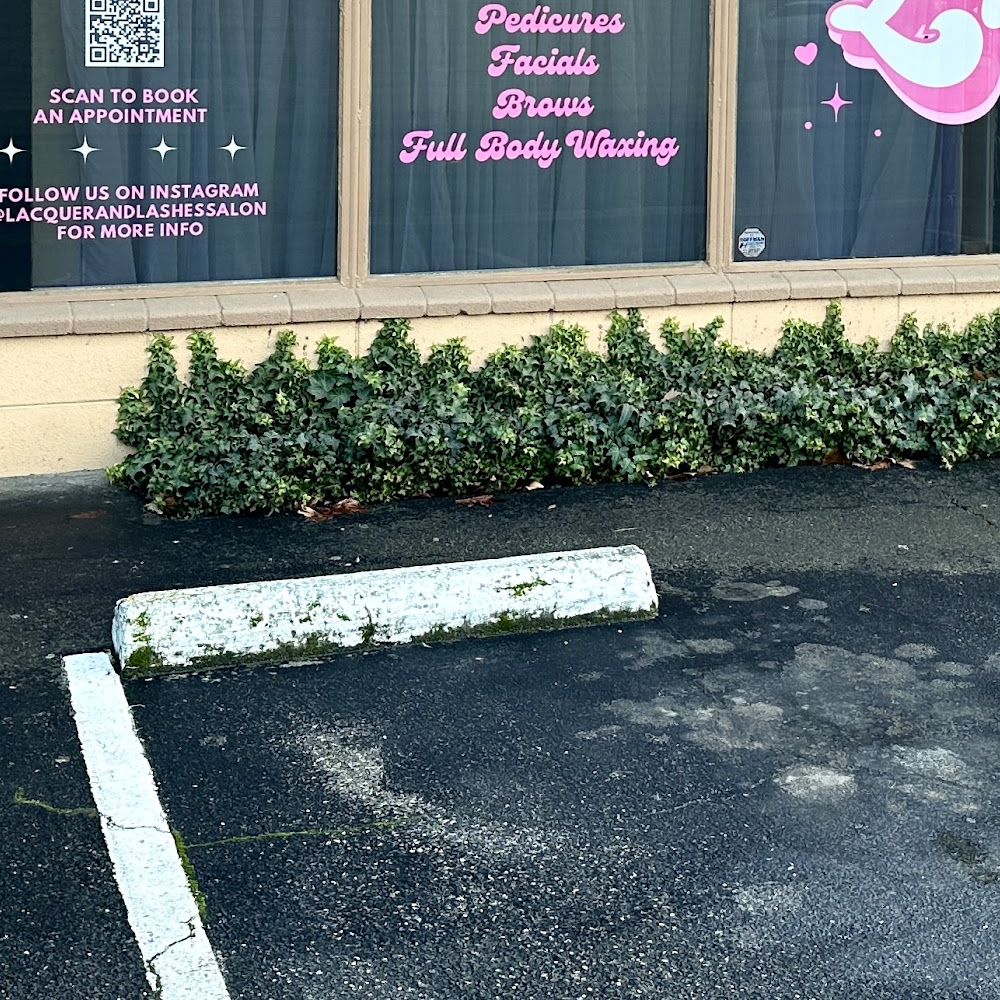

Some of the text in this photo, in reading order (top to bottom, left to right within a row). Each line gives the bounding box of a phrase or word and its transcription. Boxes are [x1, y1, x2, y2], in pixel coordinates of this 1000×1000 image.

[474, 3, 626, 35] Pedicures
[487, 44, 600, 77] Facials
[49, 88, 199, 104] SCAN TO BOOK
[492, 88, 595, 120] Brows
[33, 108, 208, 124] AN APPOINTMENT
[399, 128, 680, 169] Full Body Waxing
[0, 183, 259, 203] FOLLOW US ON INSTAGRAM
[57, 221, 204, 240] FOR MORE INFO
